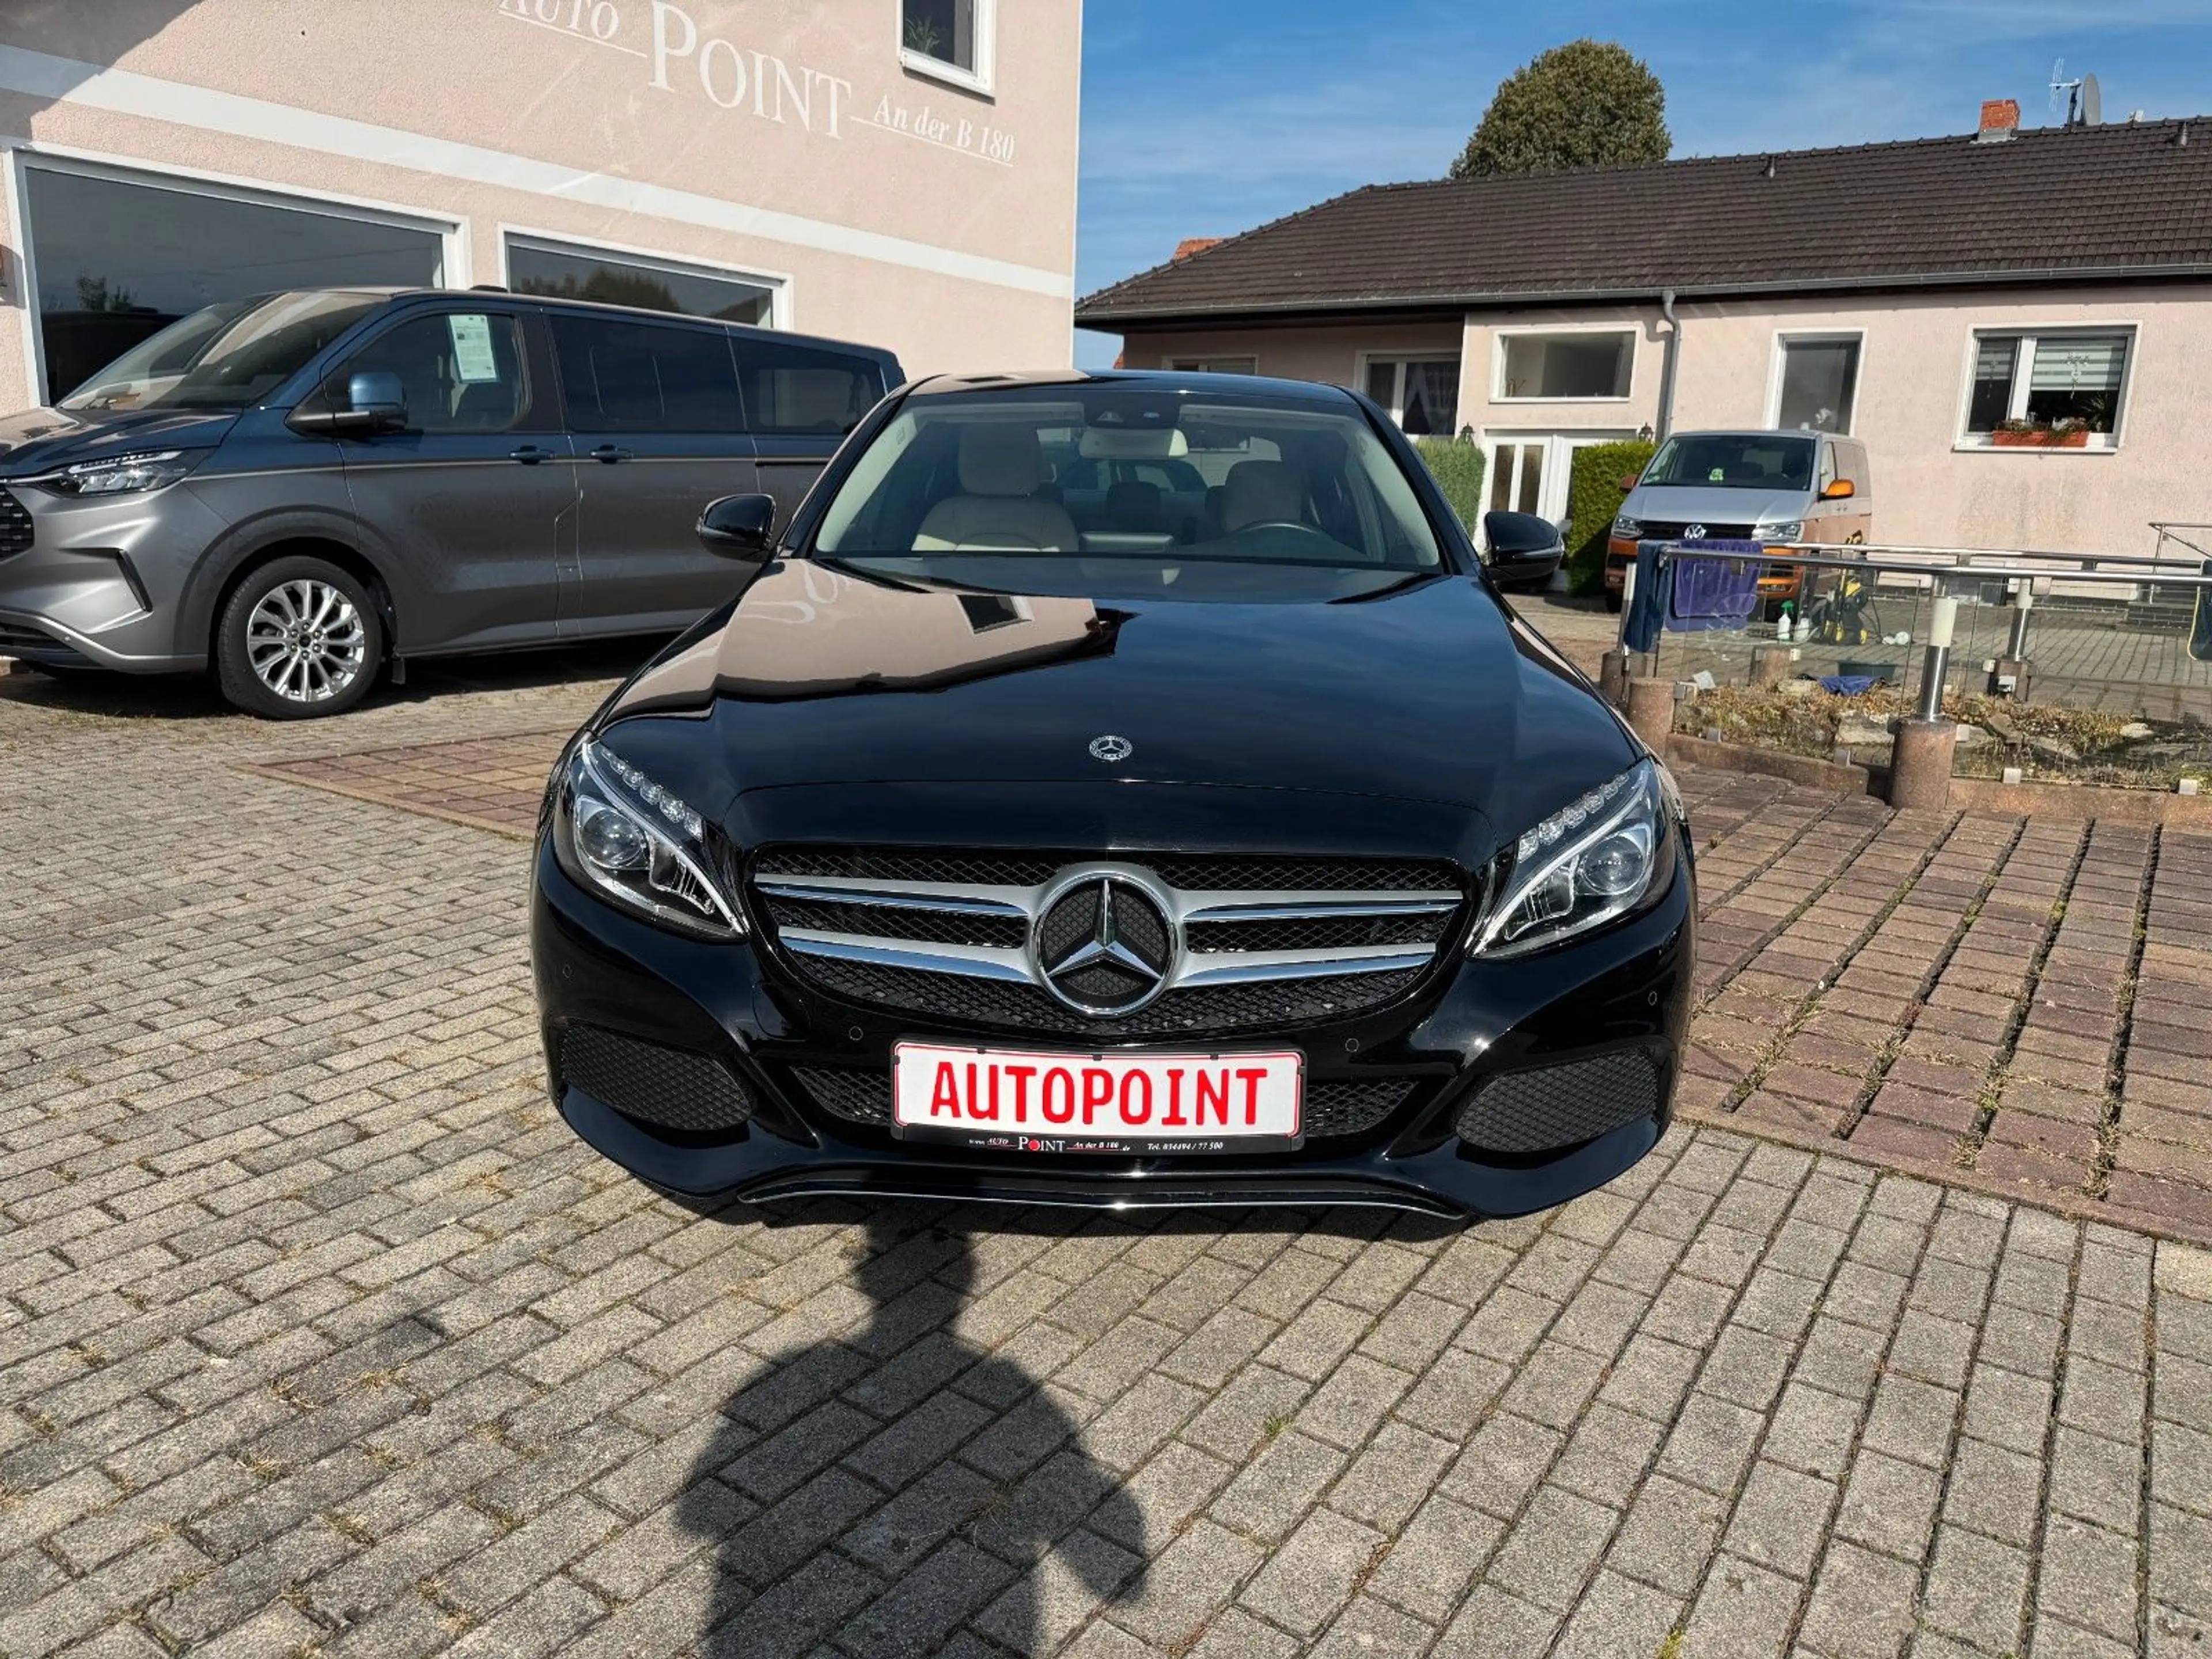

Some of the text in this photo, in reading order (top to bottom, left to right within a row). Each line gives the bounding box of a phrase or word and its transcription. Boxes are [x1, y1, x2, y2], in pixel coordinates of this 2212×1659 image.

[647, 0, 851, 139] POINT
[873, 94, 908, 130] An
[914, 106, 949, 142] der
[956, 119, 973, 148] B
[980, 127, 1015, 162] 180
[930, 1062, 1268, 1126] AUTOPOINT
[1017, 1136, 1065, 1152] POINT
